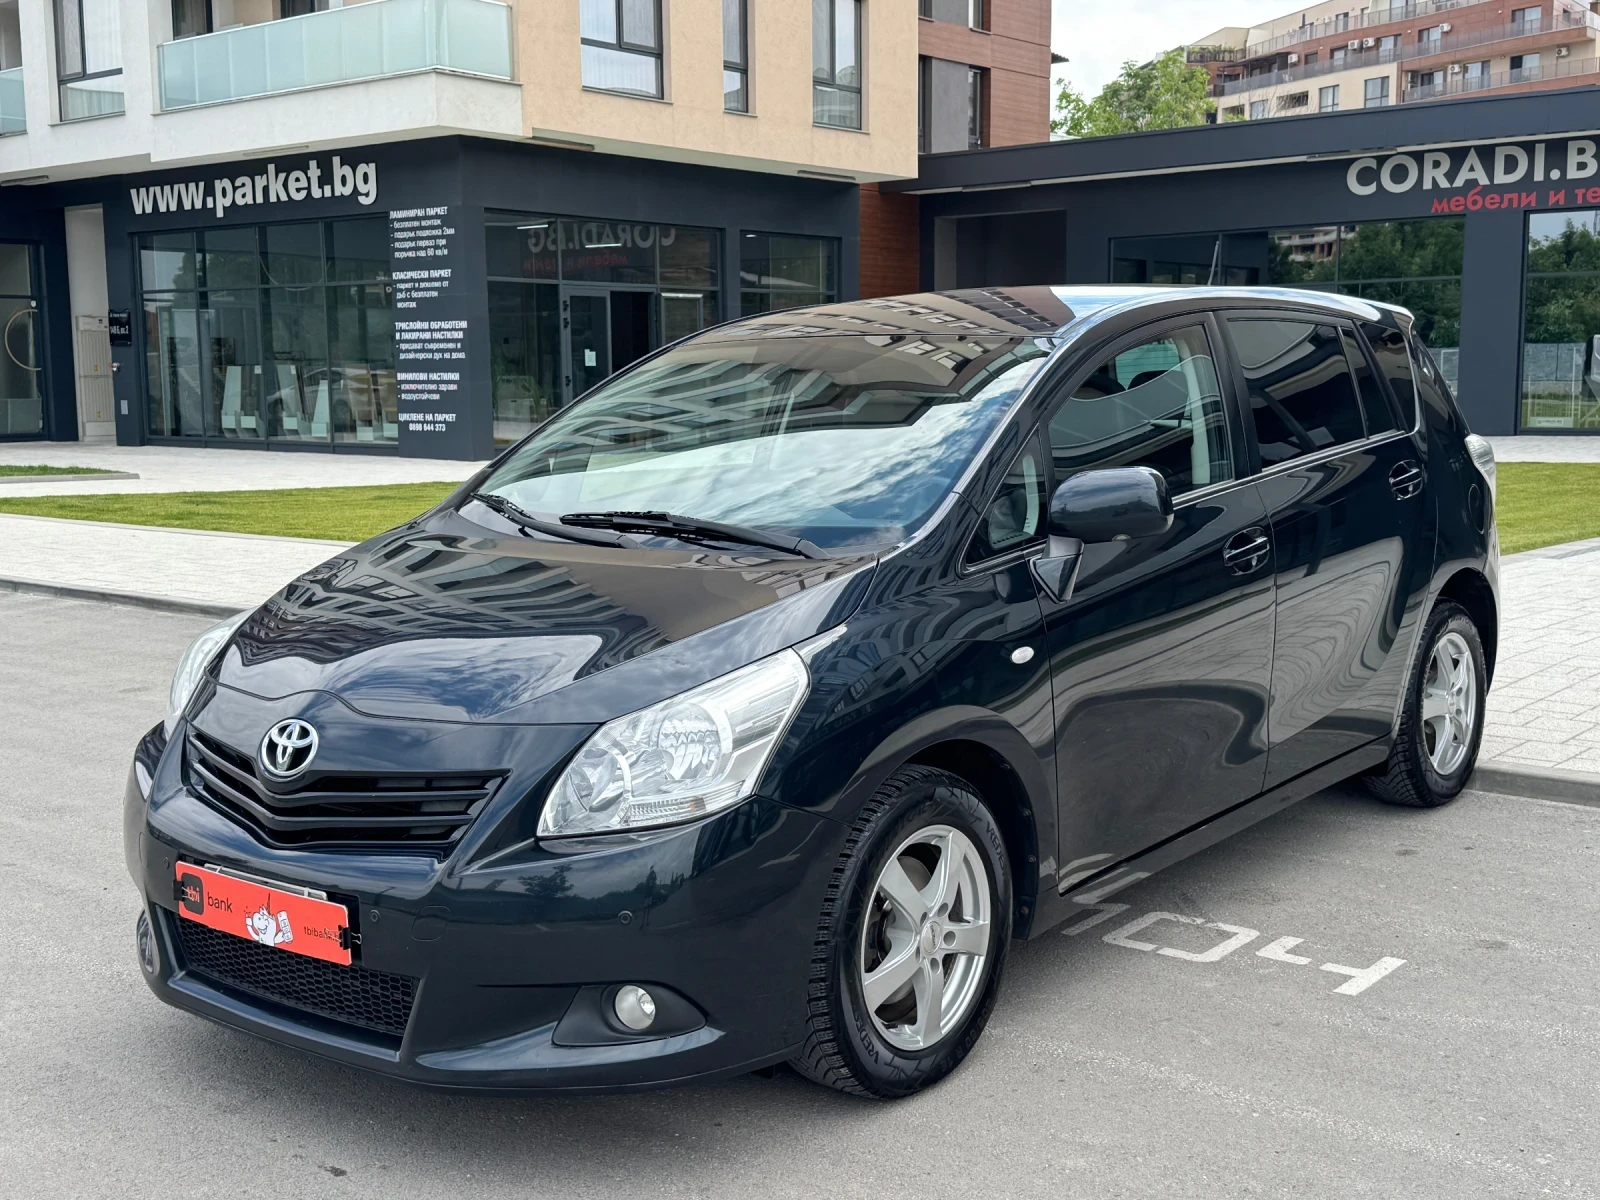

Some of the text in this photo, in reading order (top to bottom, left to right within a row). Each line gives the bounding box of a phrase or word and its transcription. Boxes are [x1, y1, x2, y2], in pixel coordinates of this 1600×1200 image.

[130, 156, 377, 218] www.parket.bg
[1431, 186, 1536, 213] мебели
[1549, 189, 1565, 207] и
[390, 206, 448, 219] ЛАМИНИРАН ПАРКЕТ
[394, 219, 442, 229] безплатен монтаж
[443, 227, 455, 235] 2мм
[436, 239, 447, 247] при
[427, 248, 434, 256] 60
[392, 270, 428, 280] КЛАСИЧЕСКИ
[430, 269, 452, 278] ПАРКЕТ
[411, 290, 438, 298] безплатен
[395, 320, 468, 330] ТРИСЛОЙНИ ОБРАБОТЕНИ
[401, 331, 431, 340] ЛАКИРАНИ
[432, 331, 464, 339] НАСТИЛКИ
[397, 372, 459, 380] ВИНИЛОВИ НАСТИЛКИ
[398, 413, 456, 422] ЦИКЛЕНЕ НА ПАРКЕТ
[409, 423, 446, 432] 0898 644 373
[207, 892, 233, 913] bank
